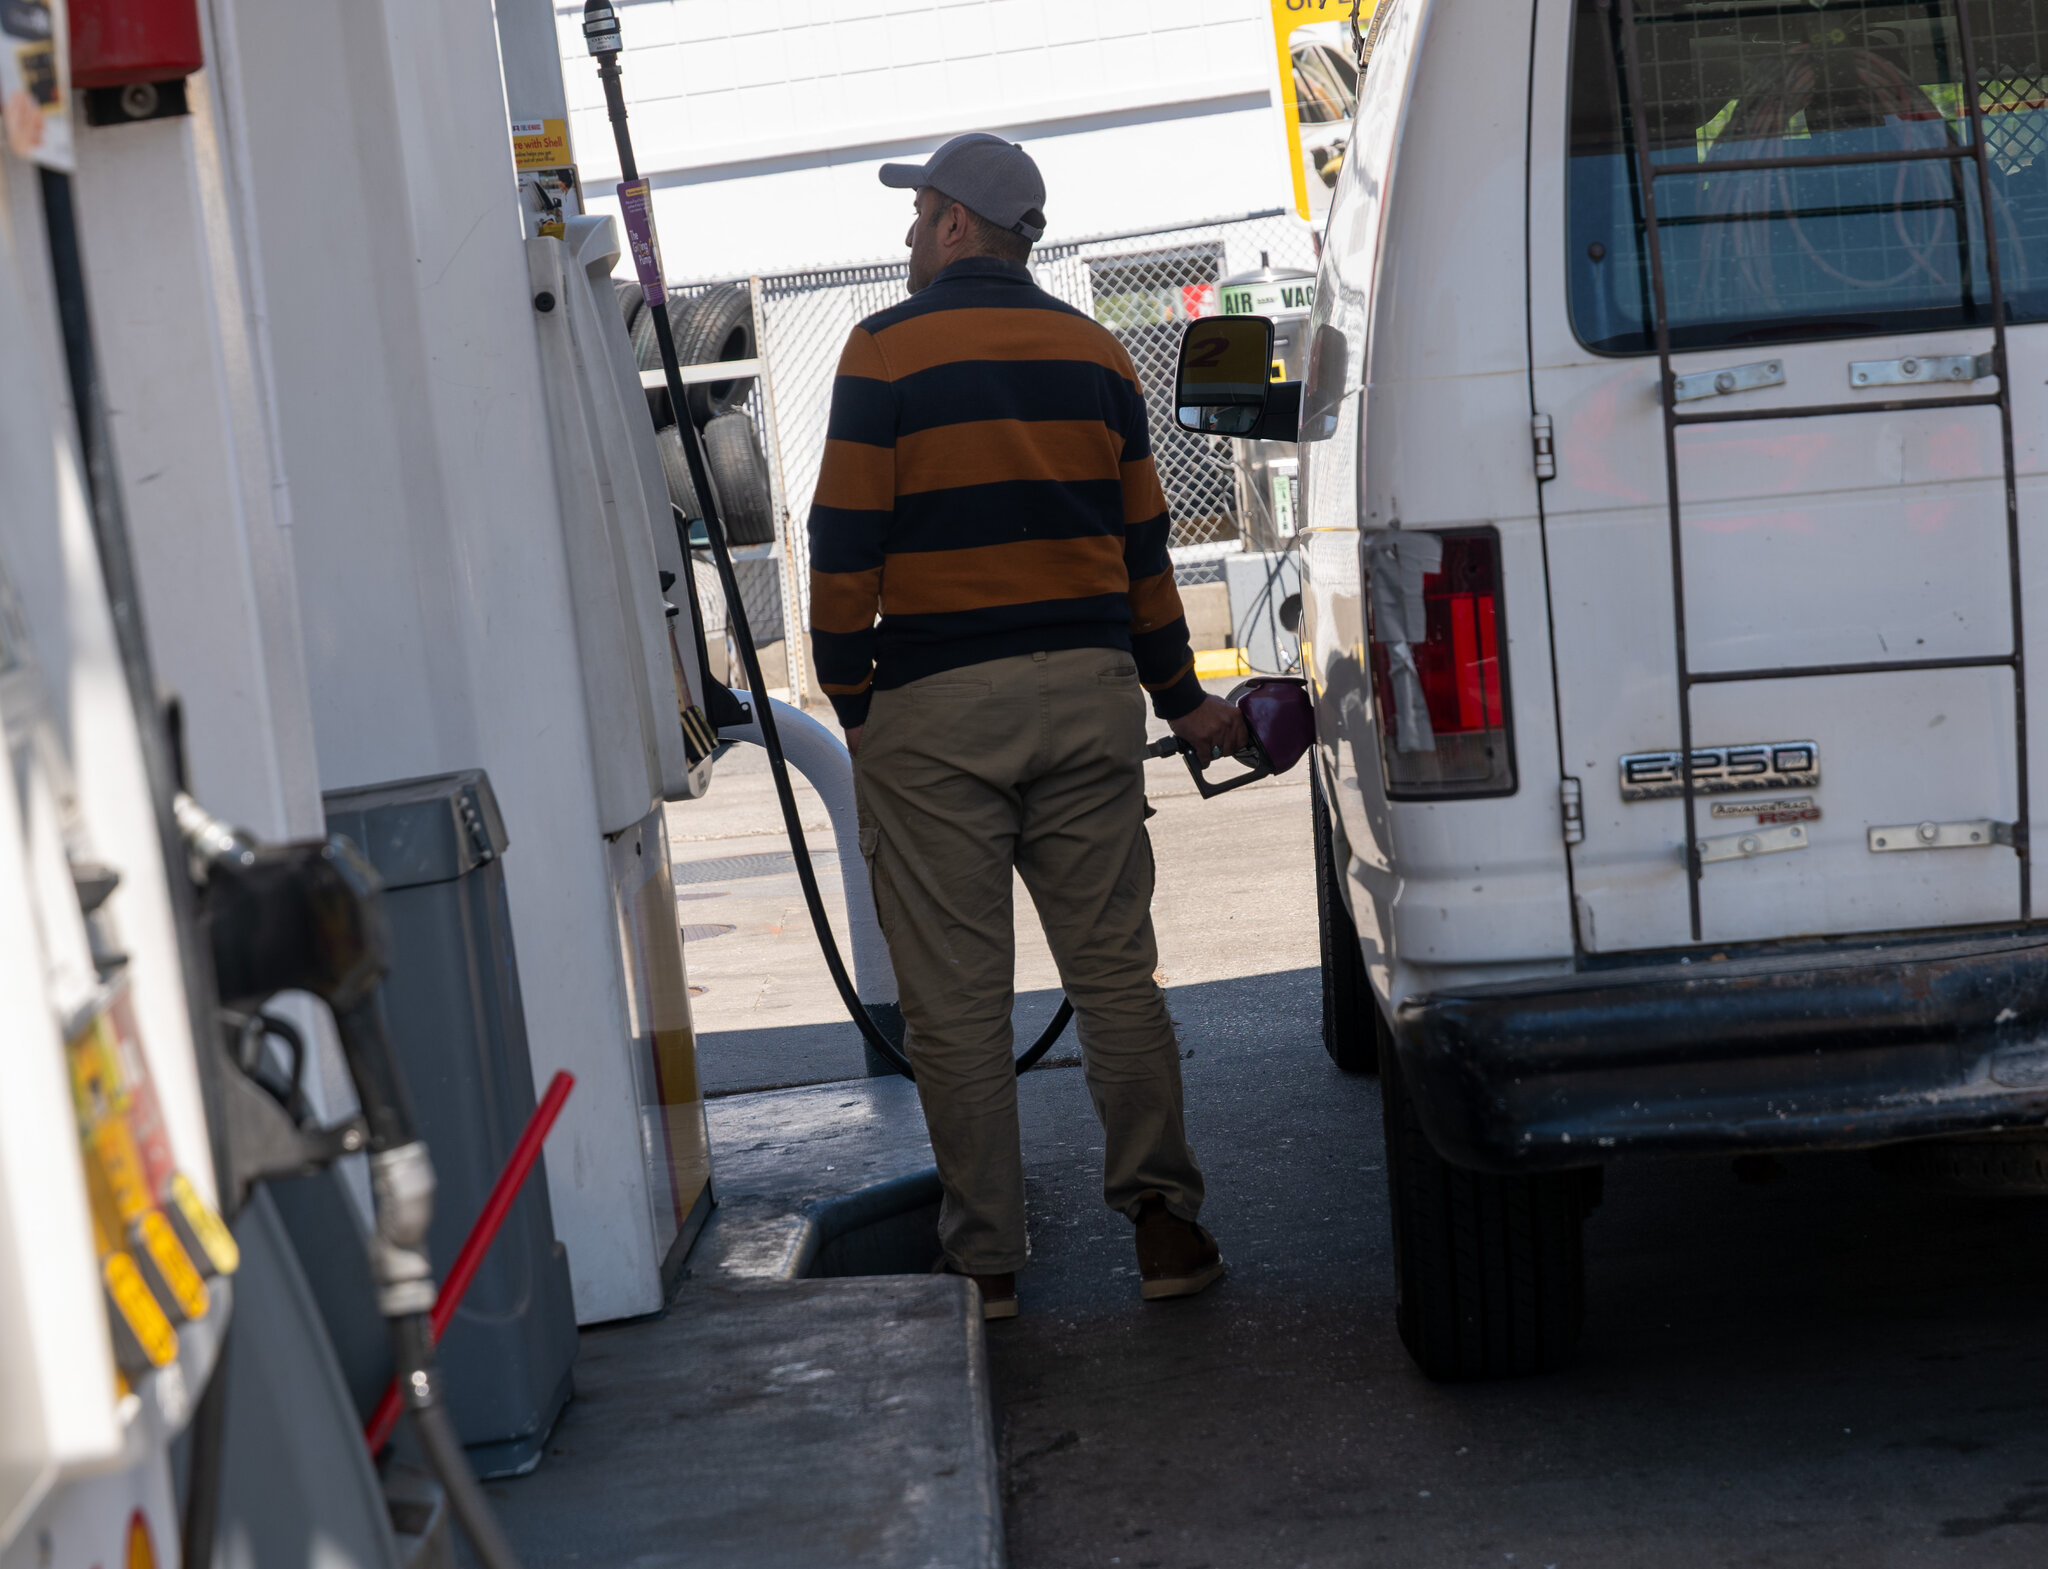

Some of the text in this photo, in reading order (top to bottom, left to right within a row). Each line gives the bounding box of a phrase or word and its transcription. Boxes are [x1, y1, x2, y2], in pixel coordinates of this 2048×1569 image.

[525, 138, 542, 149] with
[543, 136, 563, 148] Shell
[1225, 292, 1253, 314] AIR
[1186, 337, 1230, 368] 2
